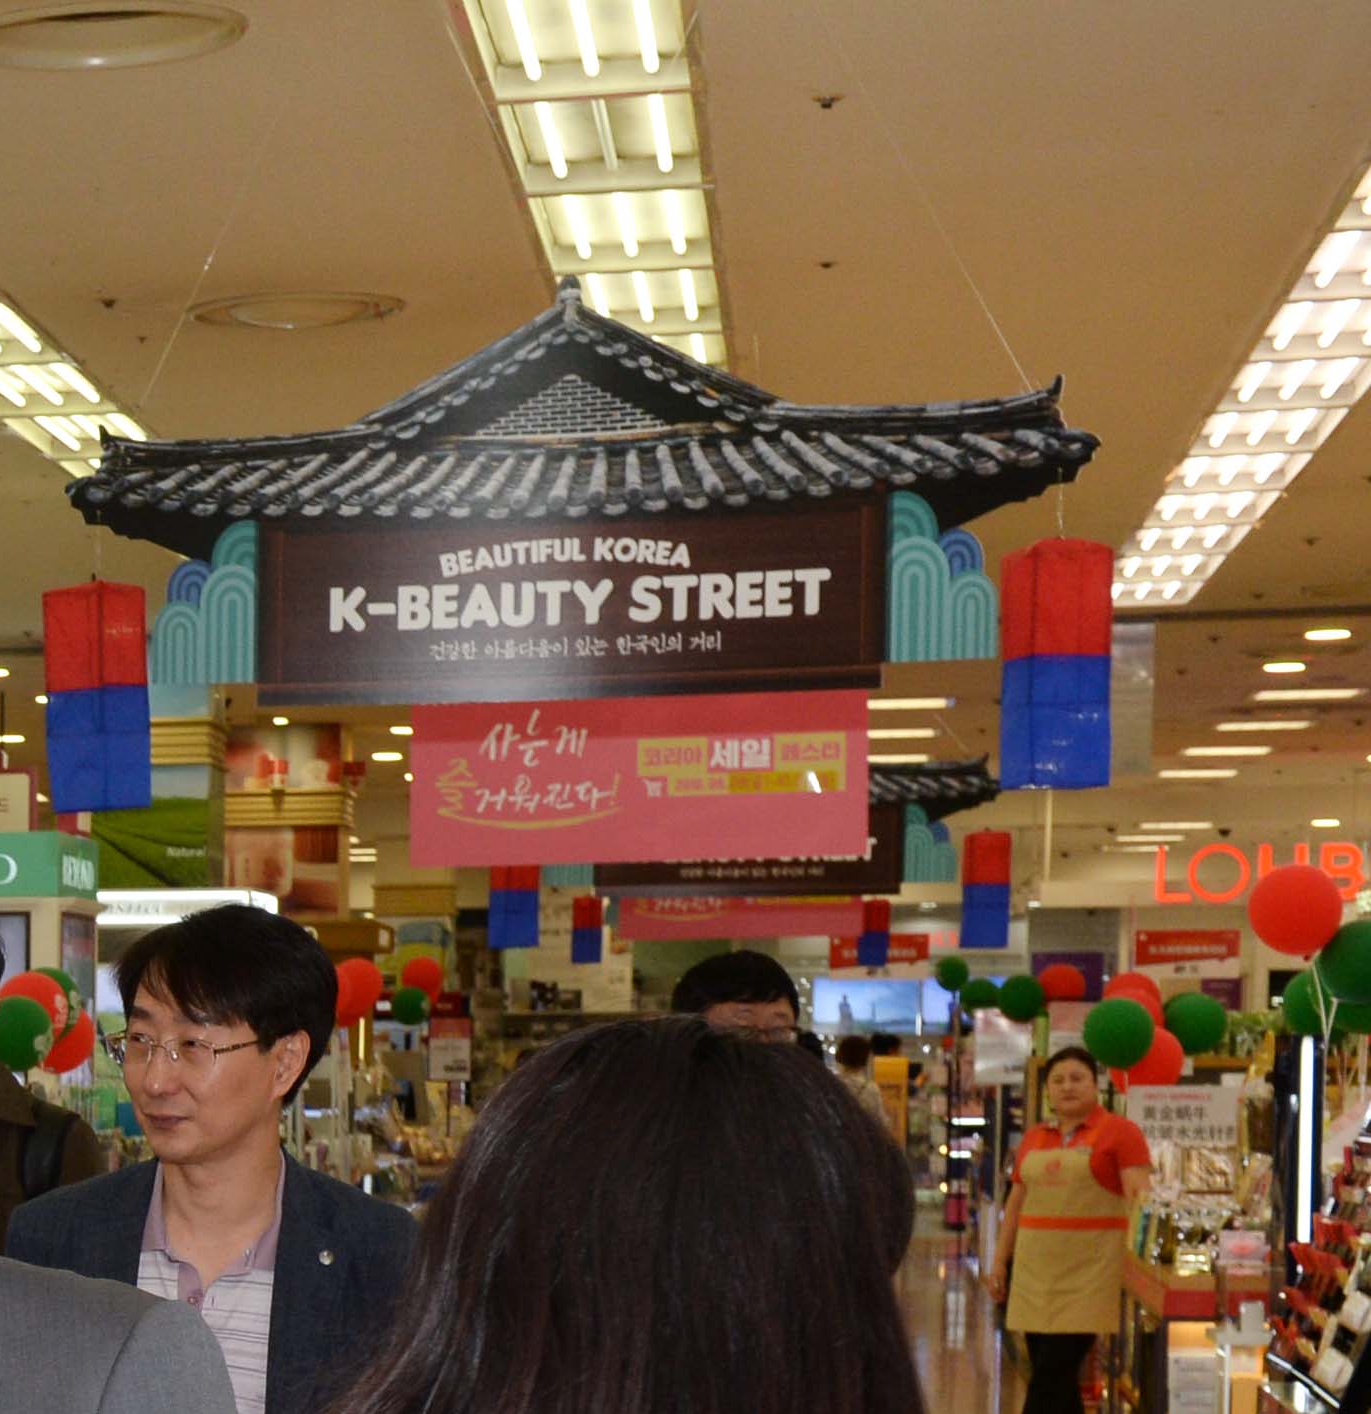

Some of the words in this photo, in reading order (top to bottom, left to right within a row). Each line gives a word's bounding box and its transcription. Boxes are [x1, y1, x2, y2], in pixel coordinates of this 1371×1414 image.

[438, 538, 586, 578] BEAUTIFUL
[593, 536, 691, 569] KOREA
[328, 578, 614, 633] K-BEAUTY
[628, 567, 832, 622] STREET
[428, 636, 477, 662] 건강한
[574, 635, 608, 658] 있는
[615, 633, 683, 657] 한국인의
[689, 630, 723, 655] 거리
[709, 737, 772, 770] 세일
